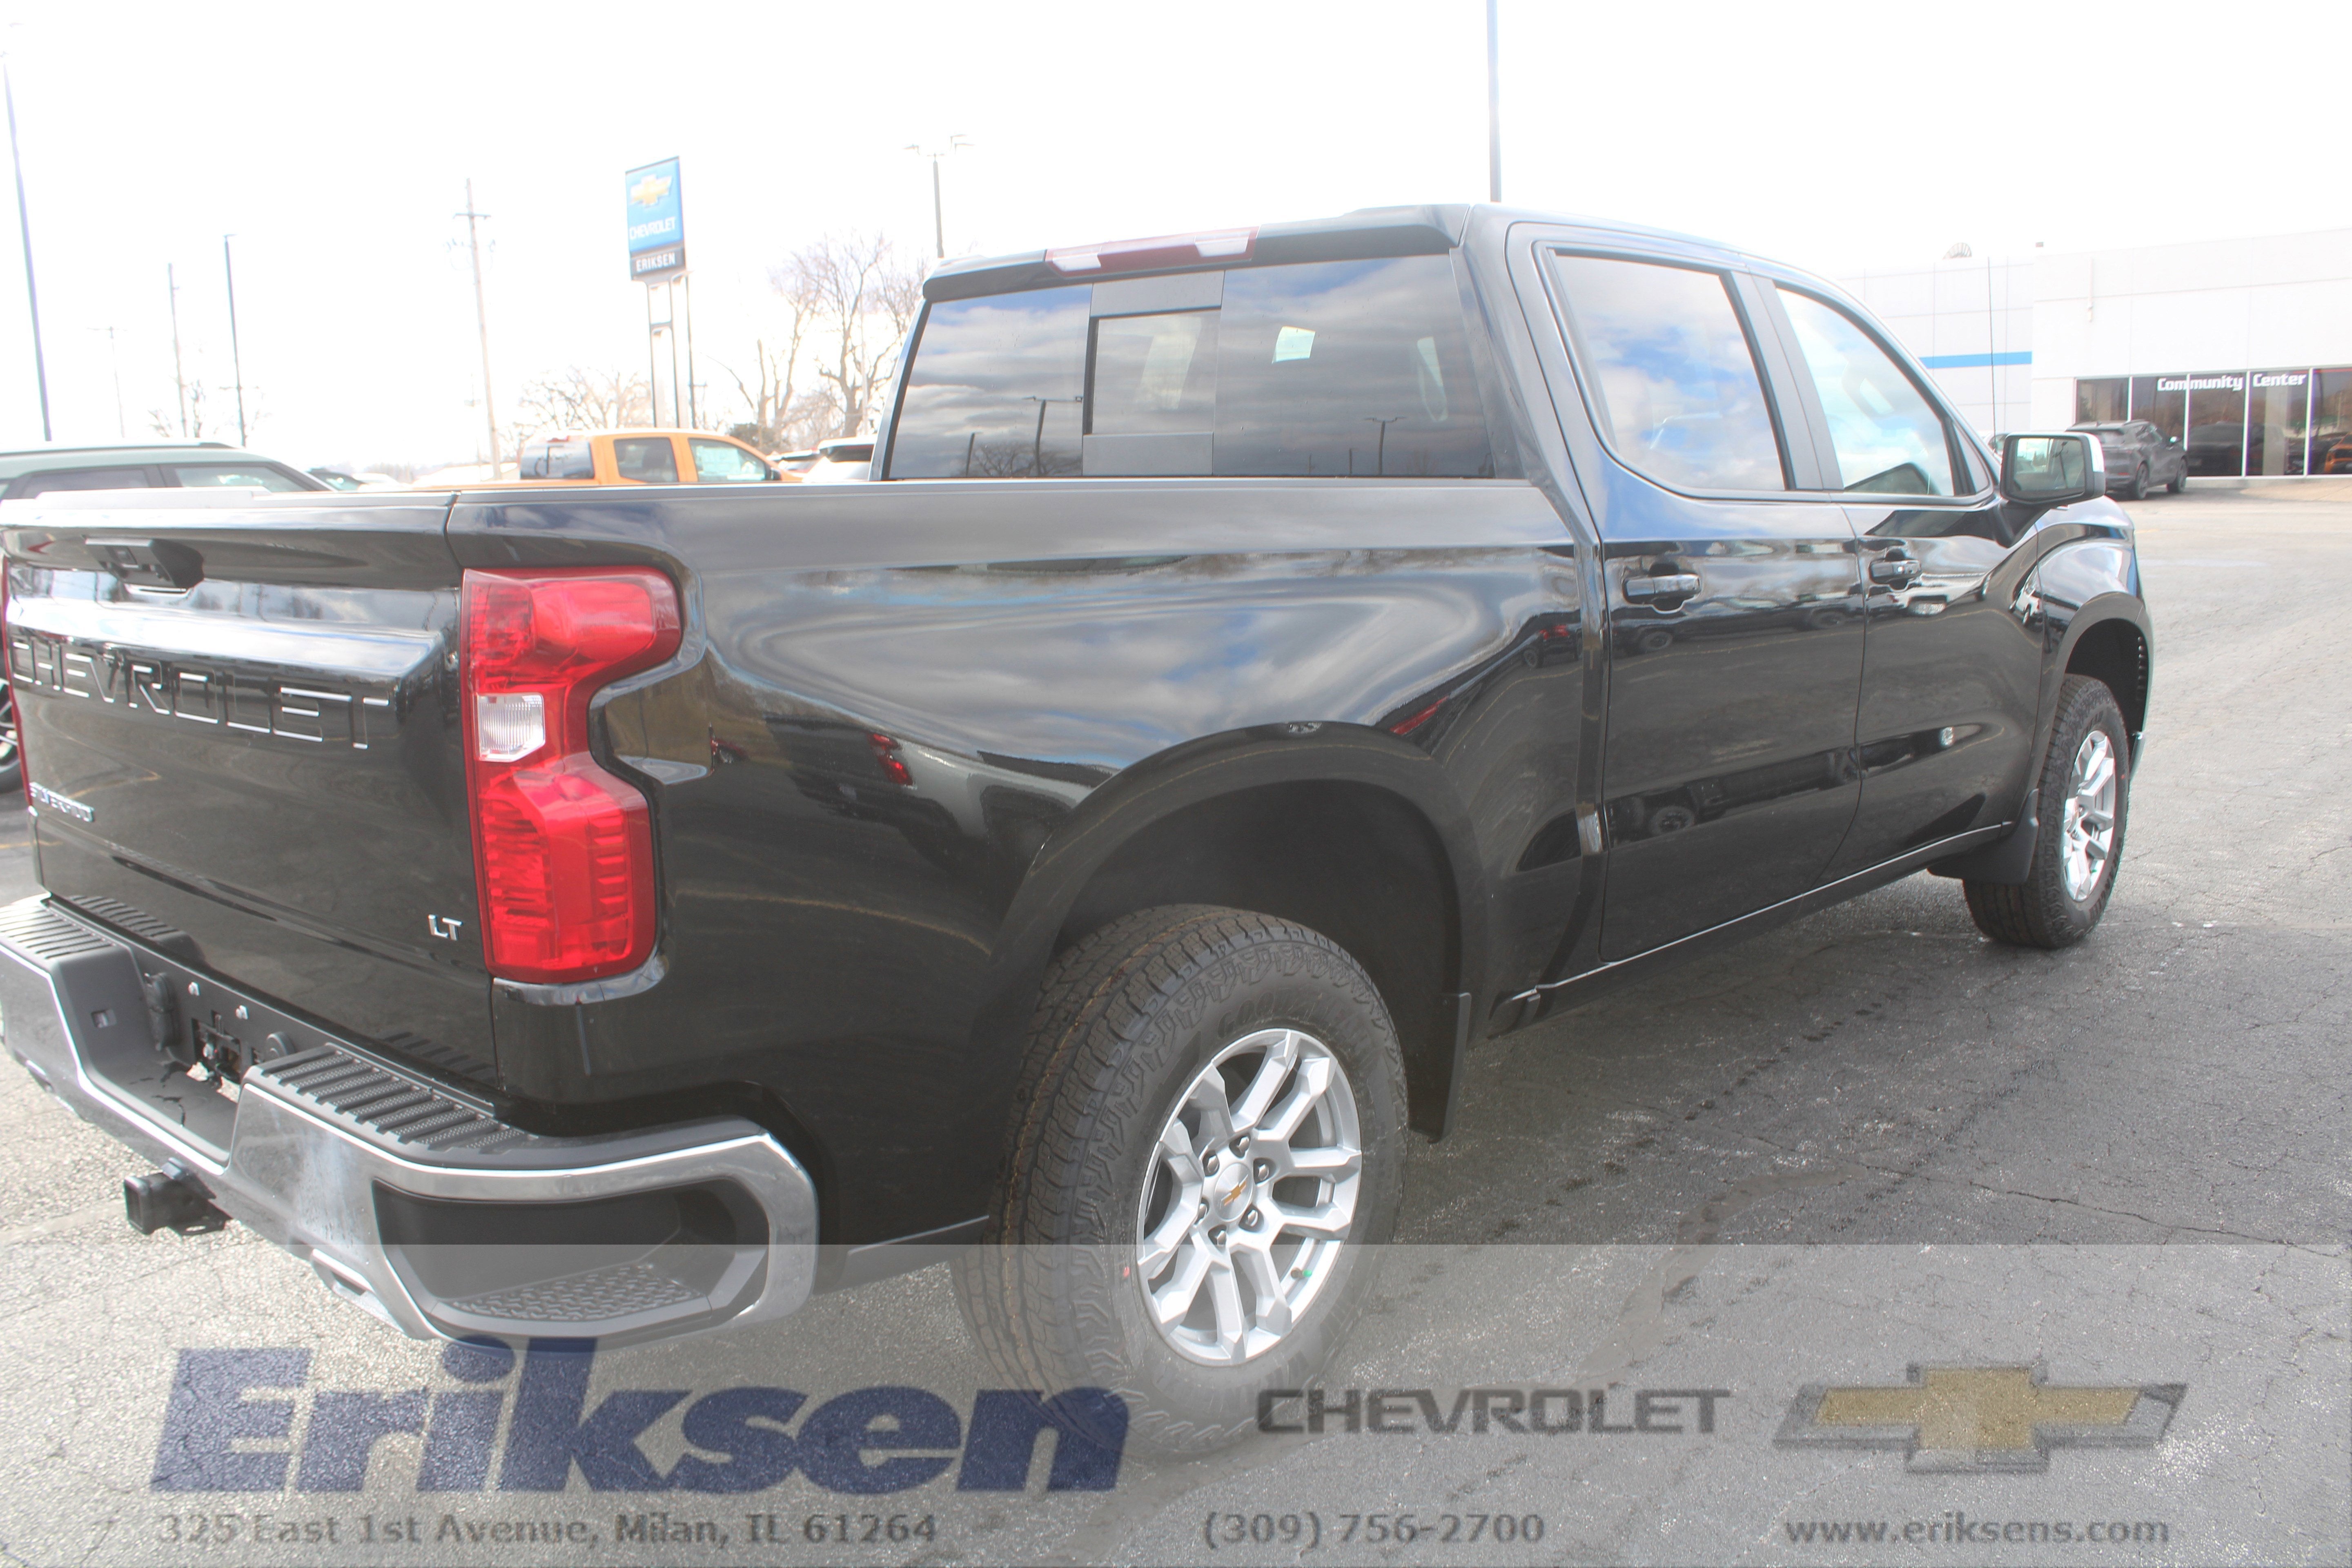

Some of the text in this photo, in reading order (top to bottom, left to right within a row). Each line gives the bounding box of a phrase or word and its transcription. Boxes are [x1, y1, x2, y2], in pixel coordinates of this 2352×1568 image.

[630, 217, 675, 239] CHEVROLET
[636, 253, 675, 272] ERIKSEN
[2157, 373, 2307, 391] Community Center
[10, 635, 391, 750] CHEVROLET
[428, 914, 463, 941] LT
